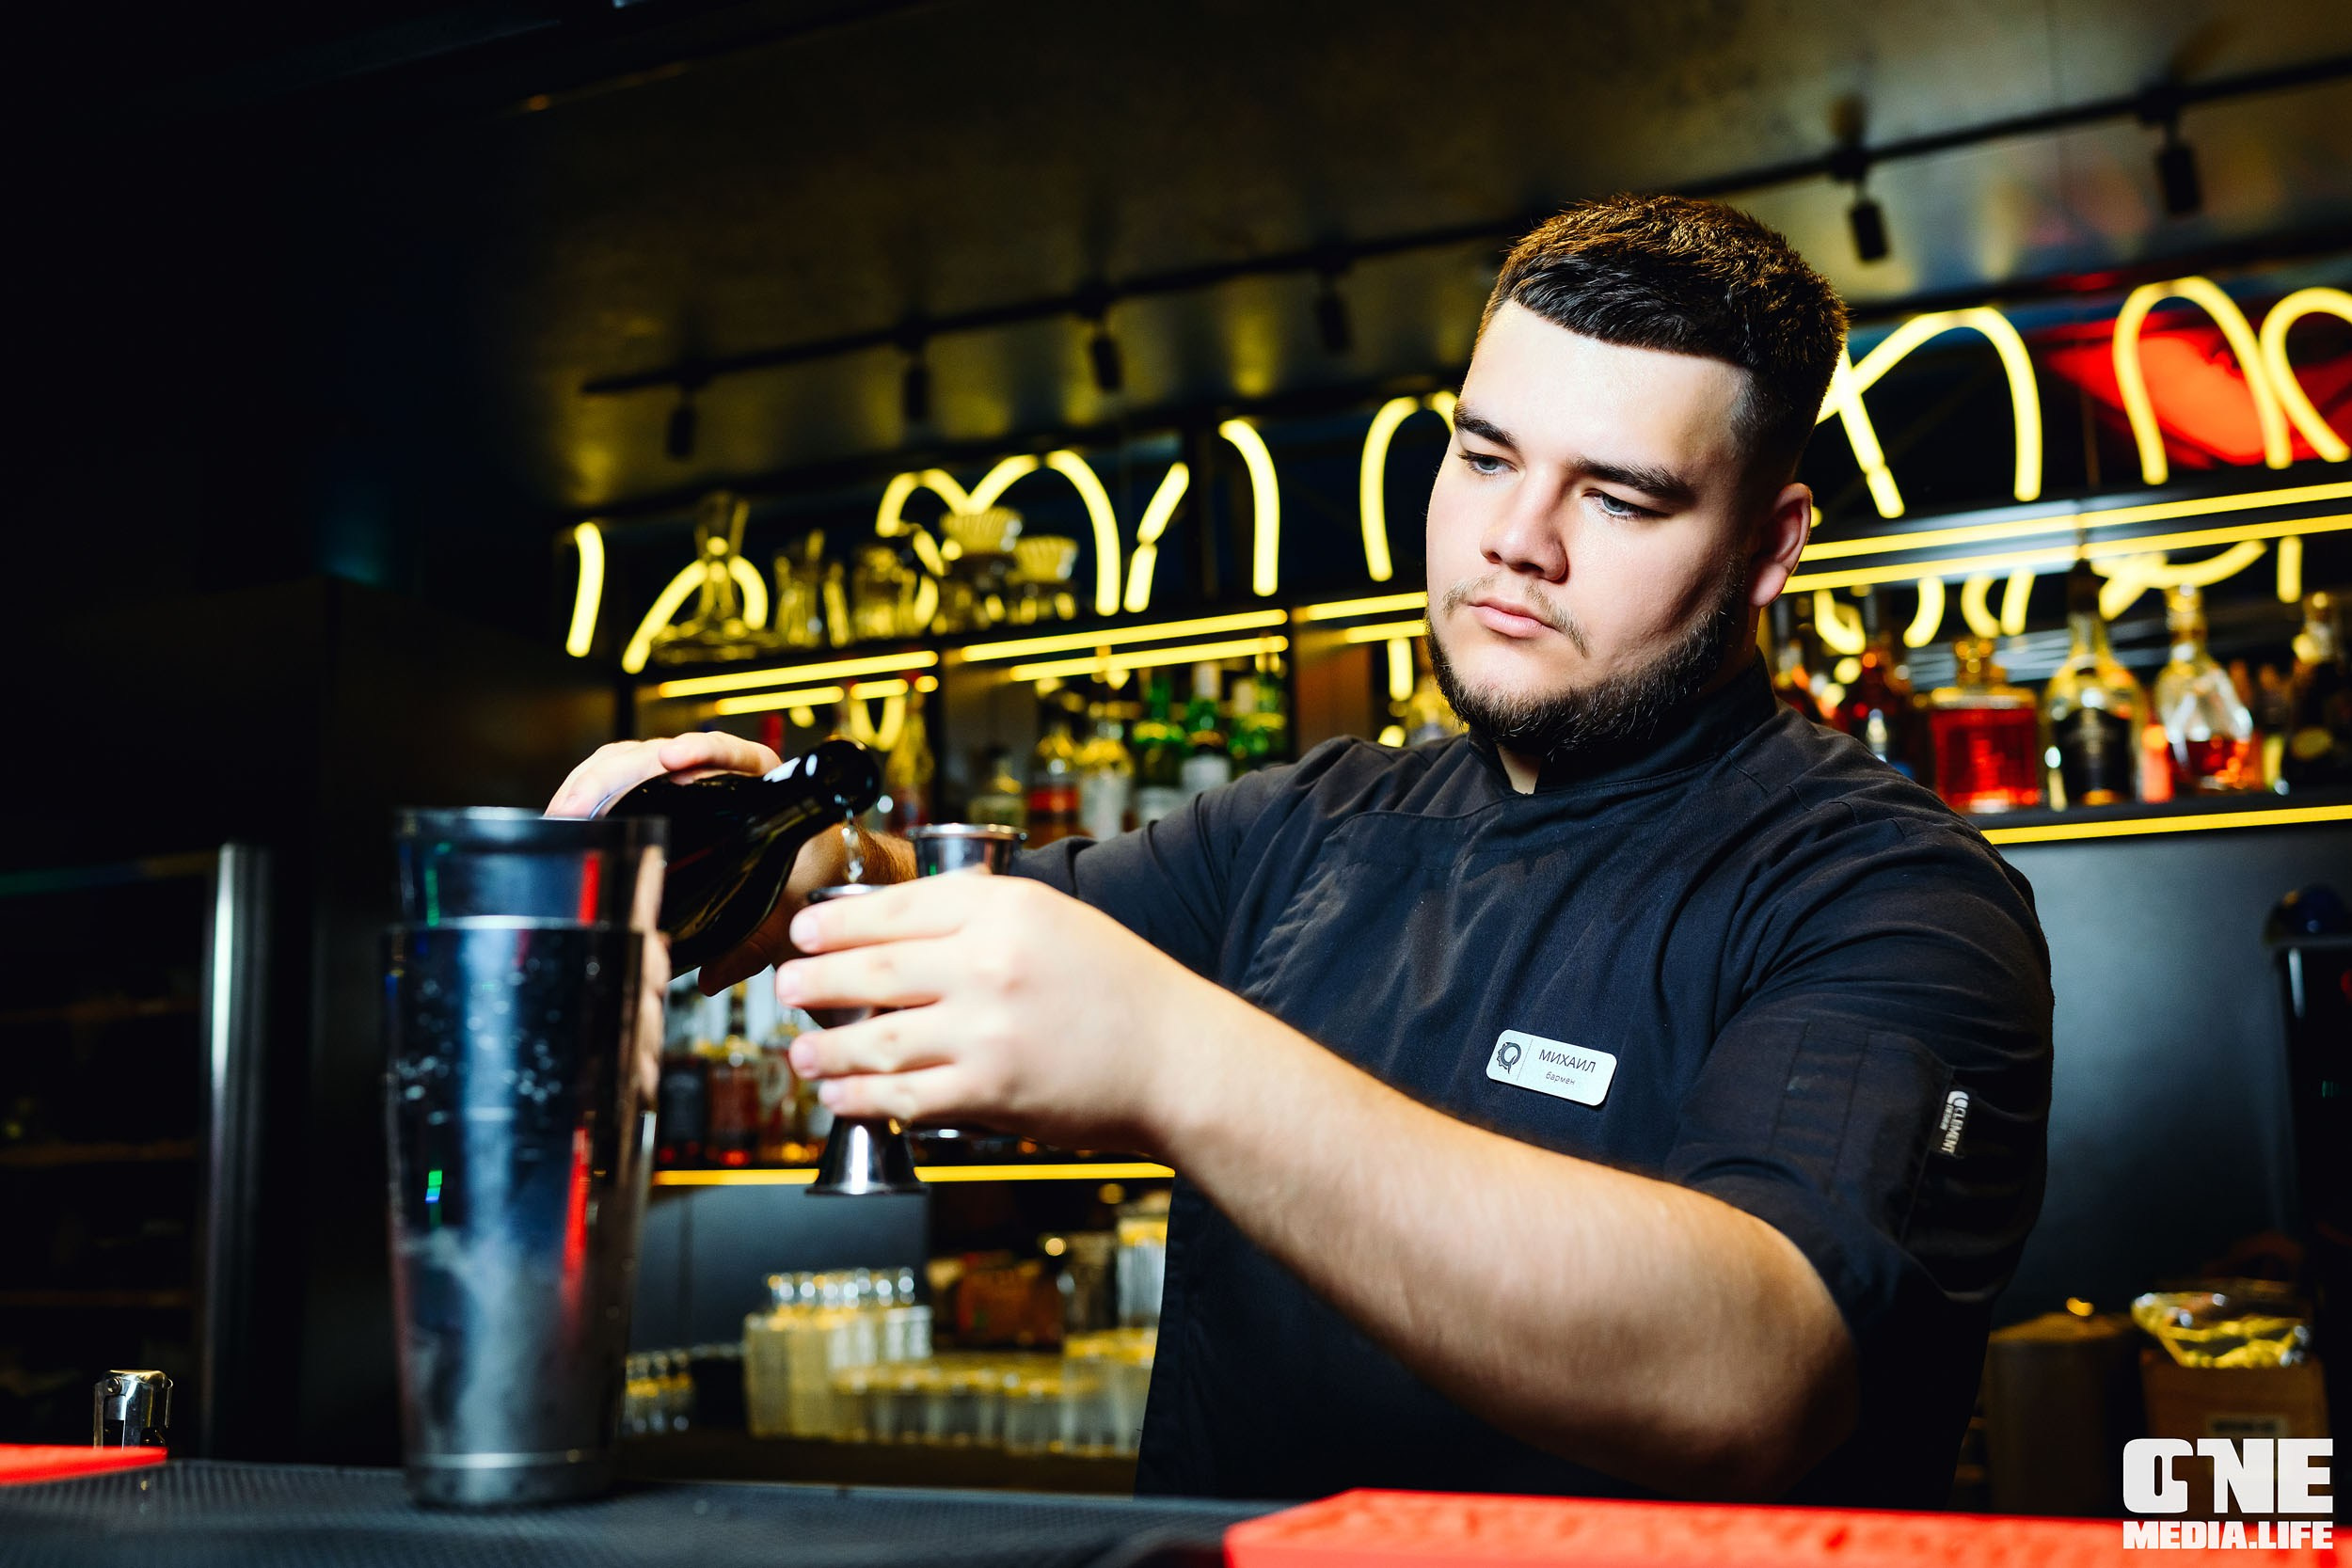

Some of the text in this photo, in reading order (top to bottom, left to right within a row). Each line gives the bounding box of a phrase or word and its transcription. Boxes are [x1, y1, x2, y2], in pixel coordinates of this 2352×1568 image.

[1538, 1049, 1597, 1073] МИХАИЛ
[1545, 1070, 1576, 1085] бармен
[1941, 1107, 1966, 1154] CLEMENT
